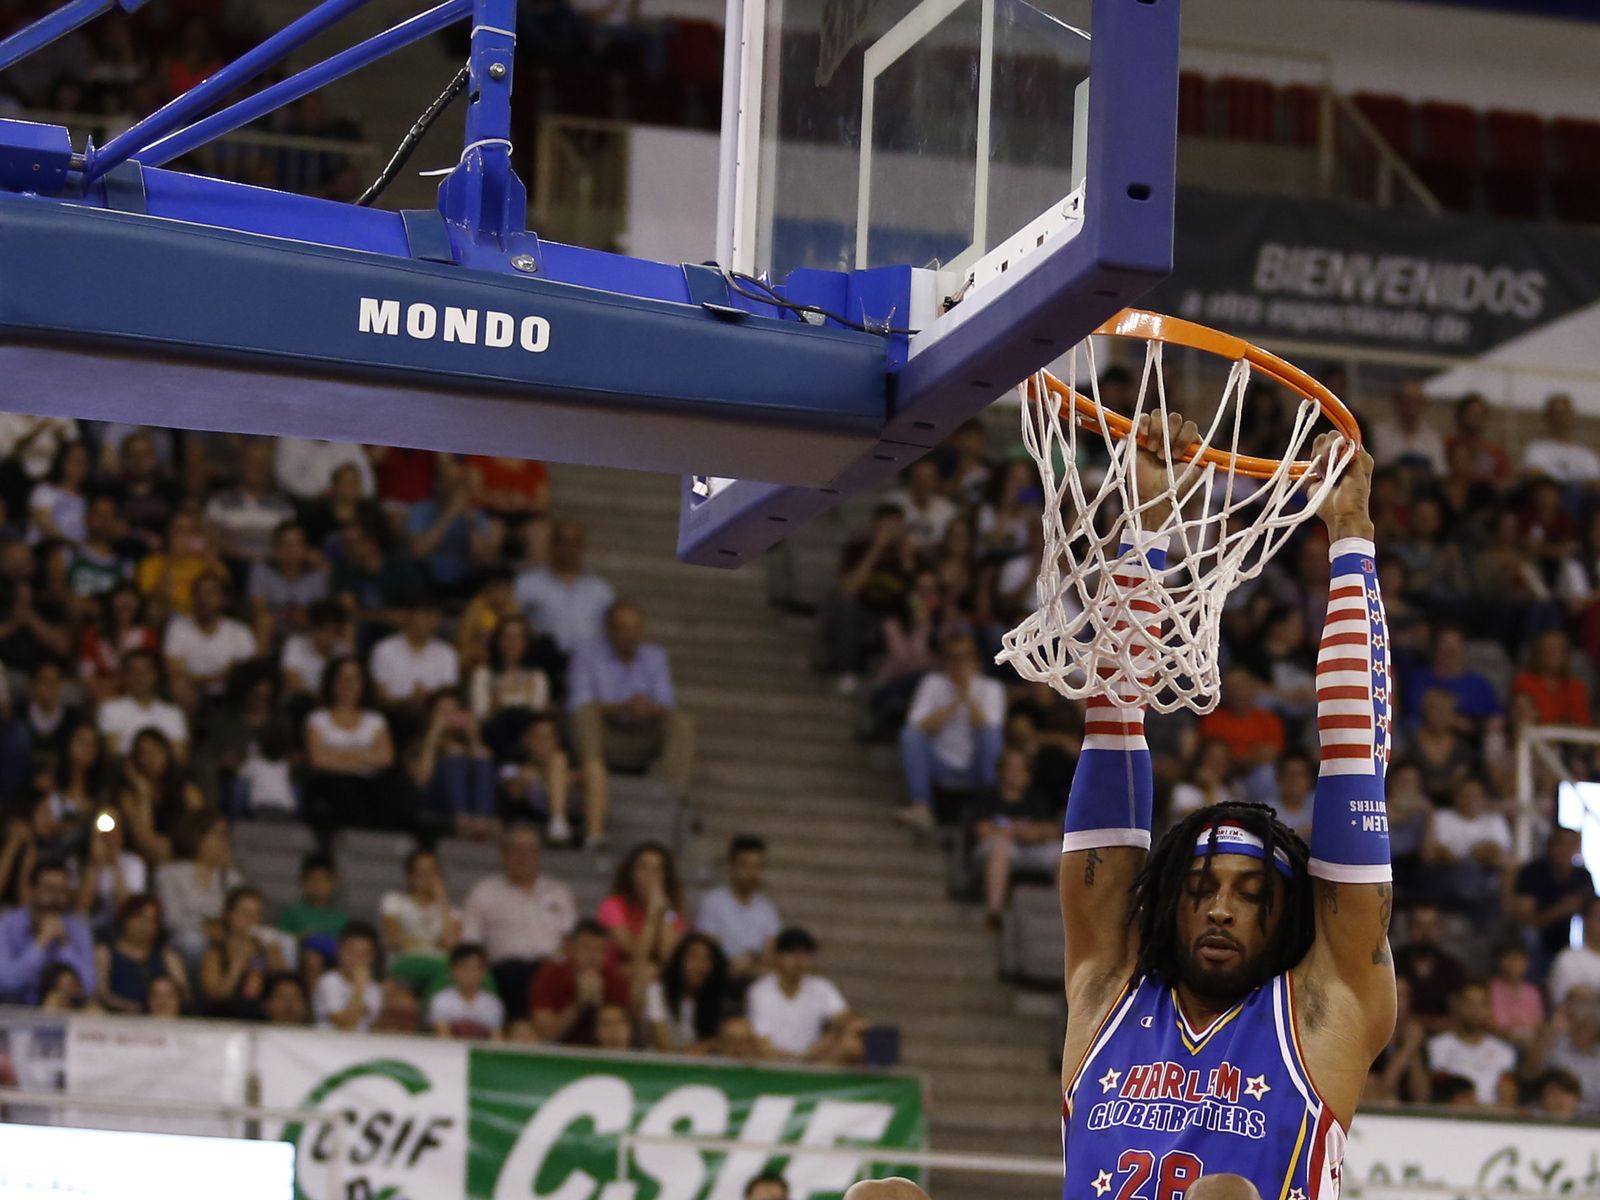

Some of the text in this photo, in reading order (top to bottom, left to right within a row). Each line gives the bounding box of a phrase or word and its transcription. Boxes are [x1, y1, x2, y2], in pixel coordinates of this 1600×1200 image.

[1254, 243, 1547, 318] BIENVENIDOS
[359, 297, 550, 353] MONDO
[1362, 815, 1389, 832] LEM
